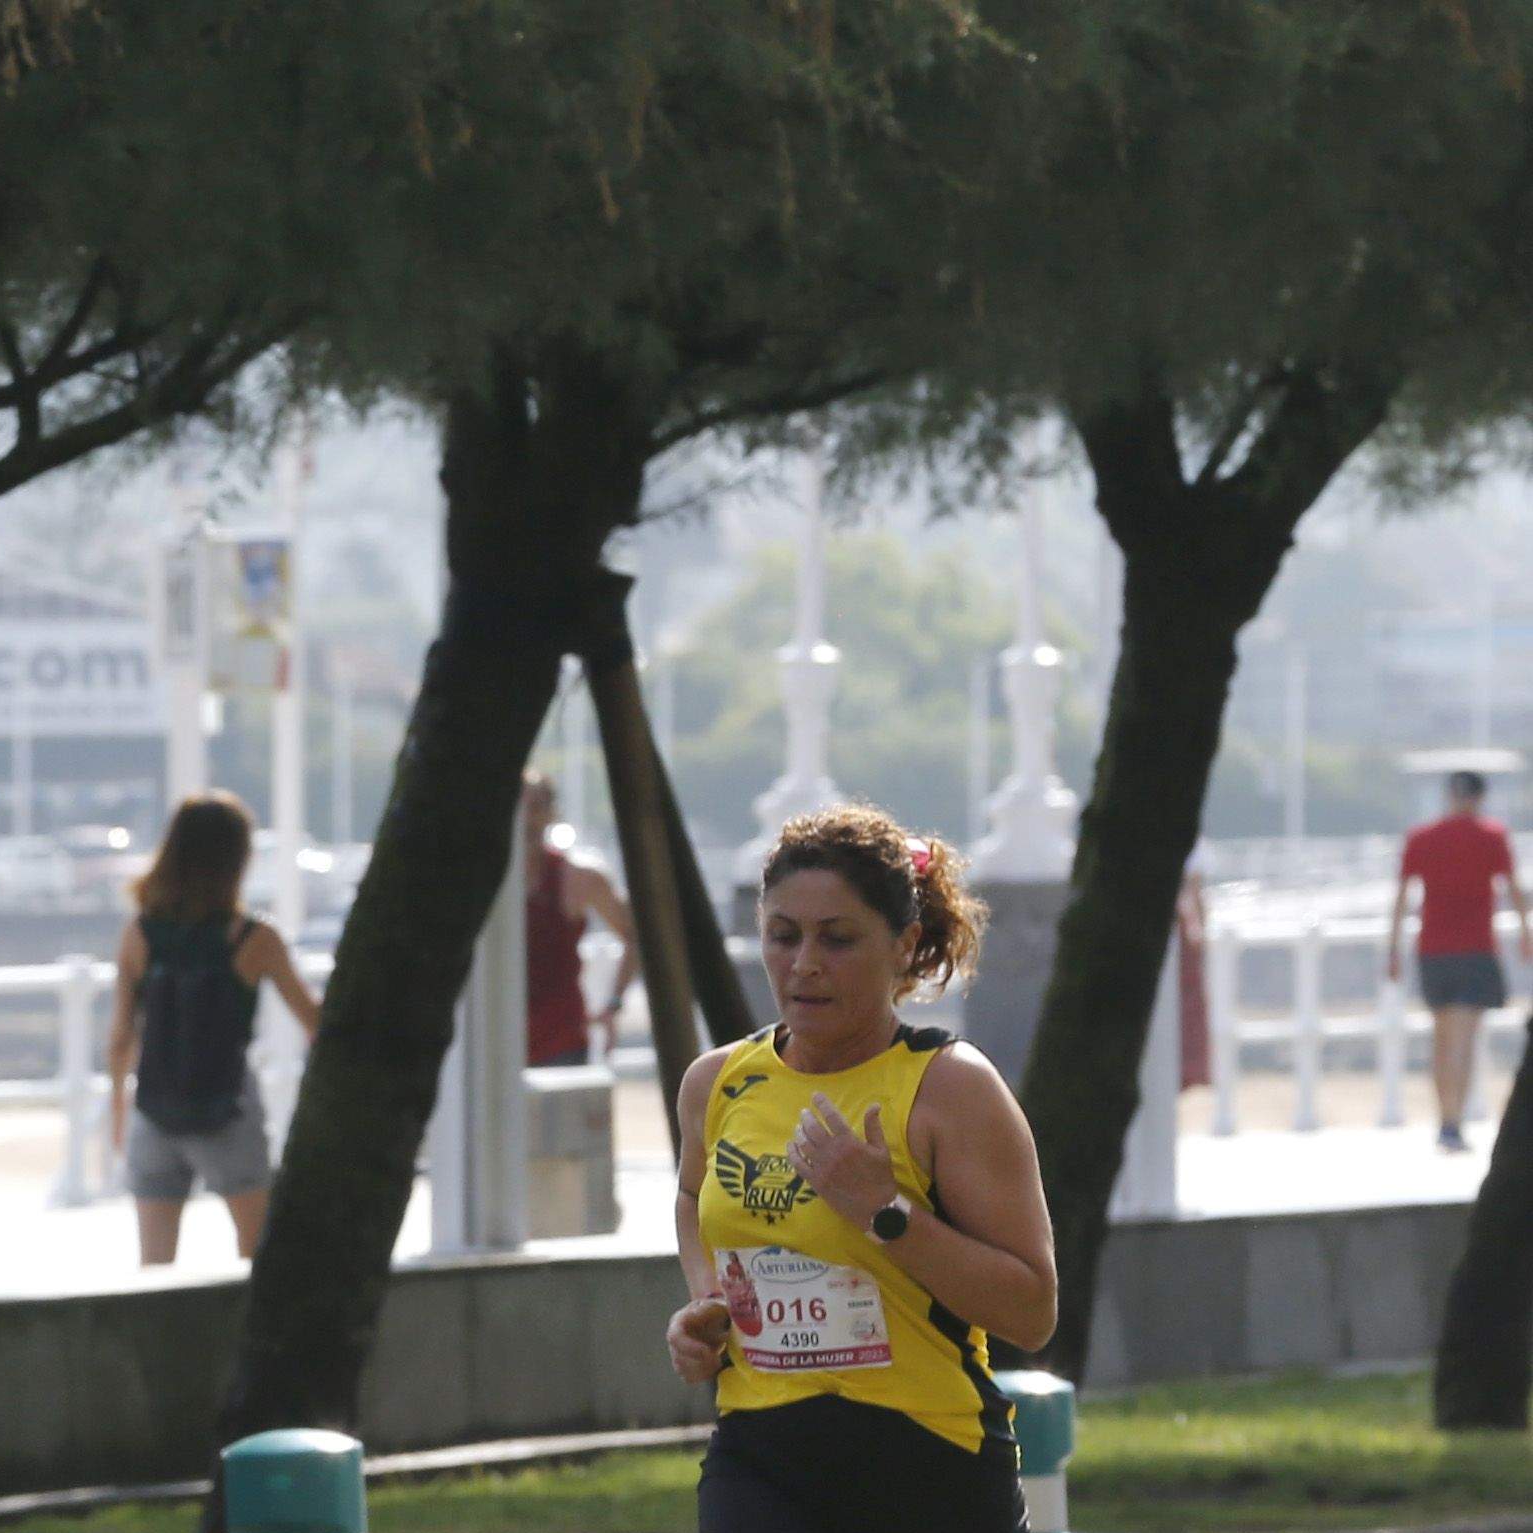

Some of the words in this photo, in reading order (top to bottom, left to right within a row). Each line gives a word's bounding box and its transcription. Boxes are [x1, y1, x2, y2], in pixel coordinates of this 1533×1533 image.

[746, 1188, 793, 1209] RUN
[767, 1298, 827, 1323] 016
[781, 1331, 819, 1348] 4390
[783, 1356, 797, 1365] DE
[800, 1355, 813, 1364] LA
[816, 1352, 854, 1364] MUJER
